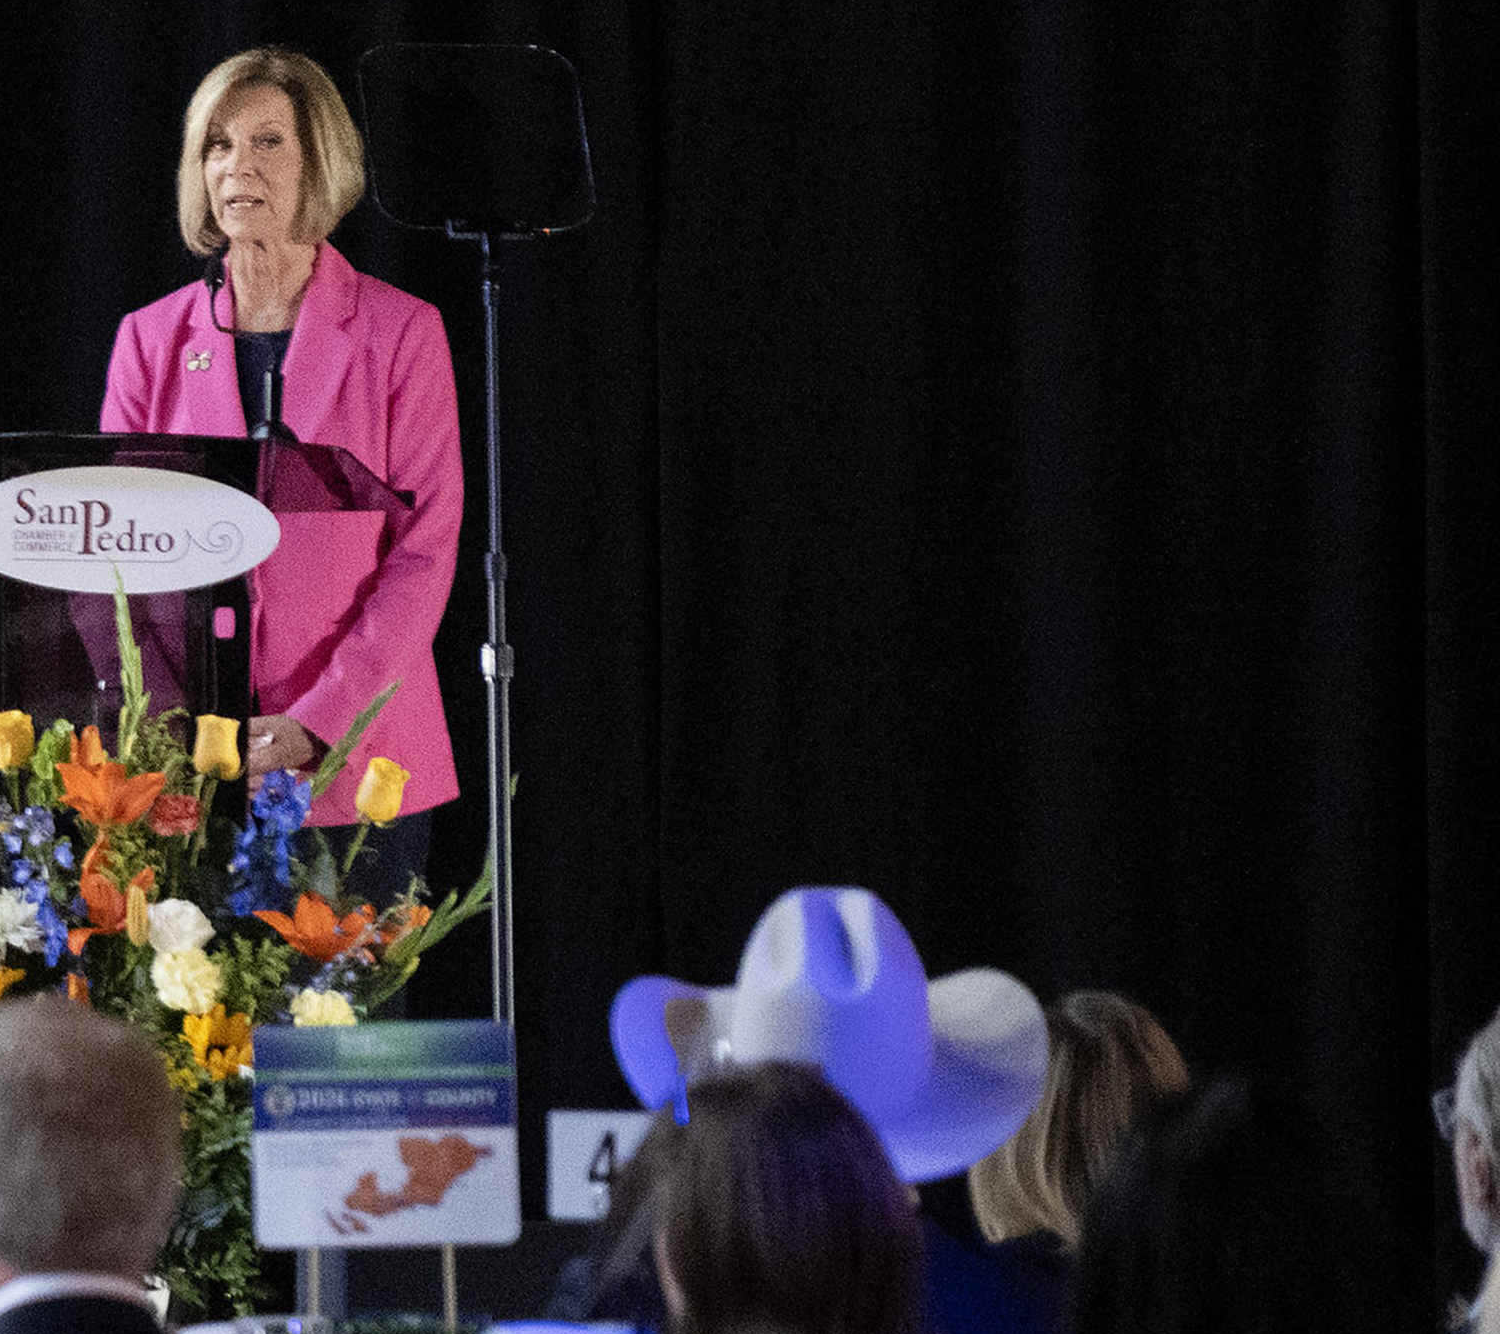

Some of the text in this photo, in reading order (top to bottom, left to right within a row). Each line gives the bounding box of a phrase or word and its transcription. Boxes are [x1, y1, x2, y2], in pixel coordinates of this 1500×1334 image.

[13, 487, 175, 555] San Pedro
[13, 541, 73, 552] COMMERCE
